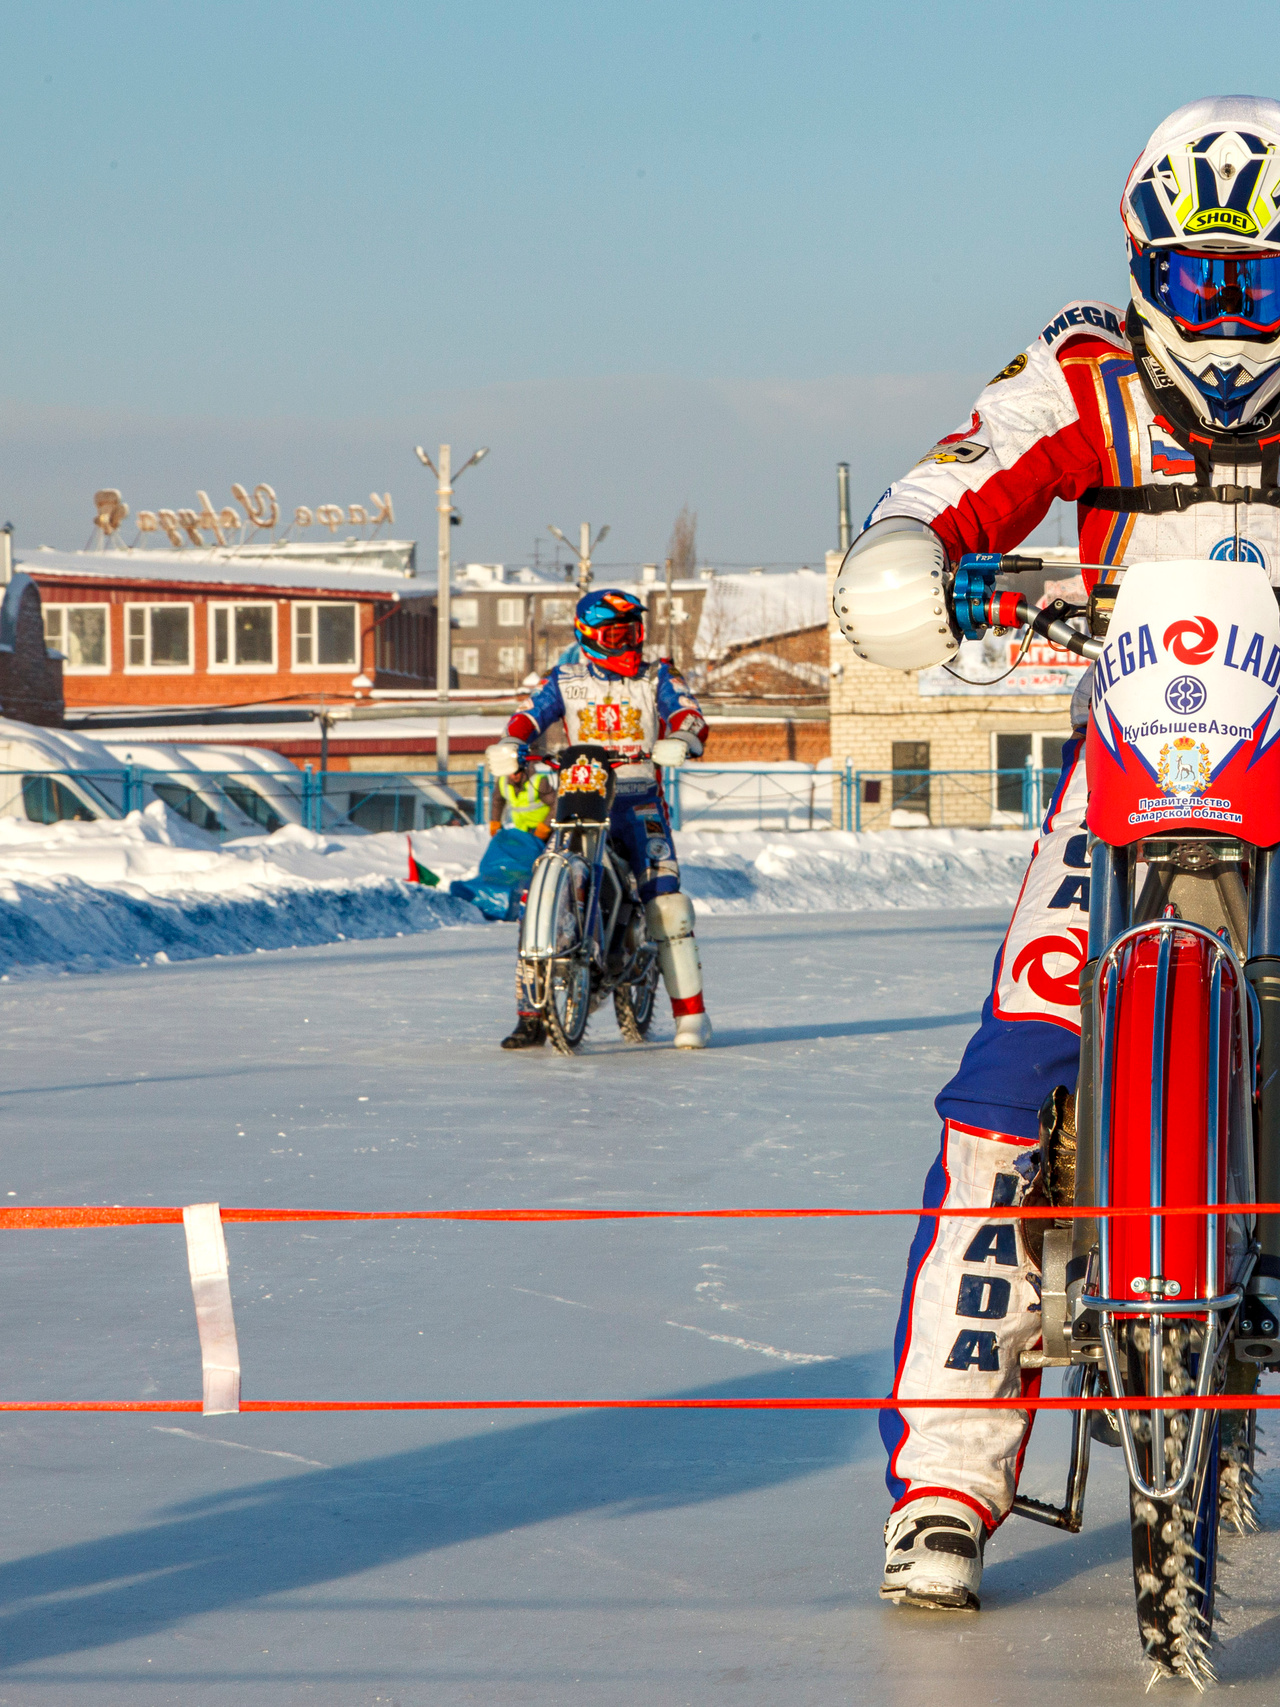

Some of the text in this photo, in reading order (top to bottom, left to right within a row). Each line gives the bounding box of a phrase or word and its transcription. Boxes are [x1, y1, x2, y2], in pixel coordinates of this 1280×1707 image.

[1196, 212, 1248, 229] SHOEI
[1042, 306, 1124, 346] MEGA
[1016, 644, 1088, 664] АГРЕ
[1094, 623, 1158, 710] MEGA
[564, 686, 588, 700] 101
[1123, 719, 1252, 744] КуйбышевАзот
[1139, 796, 1231, 811] Правительство
[1129, 806, 1243, 825] Самарской области
